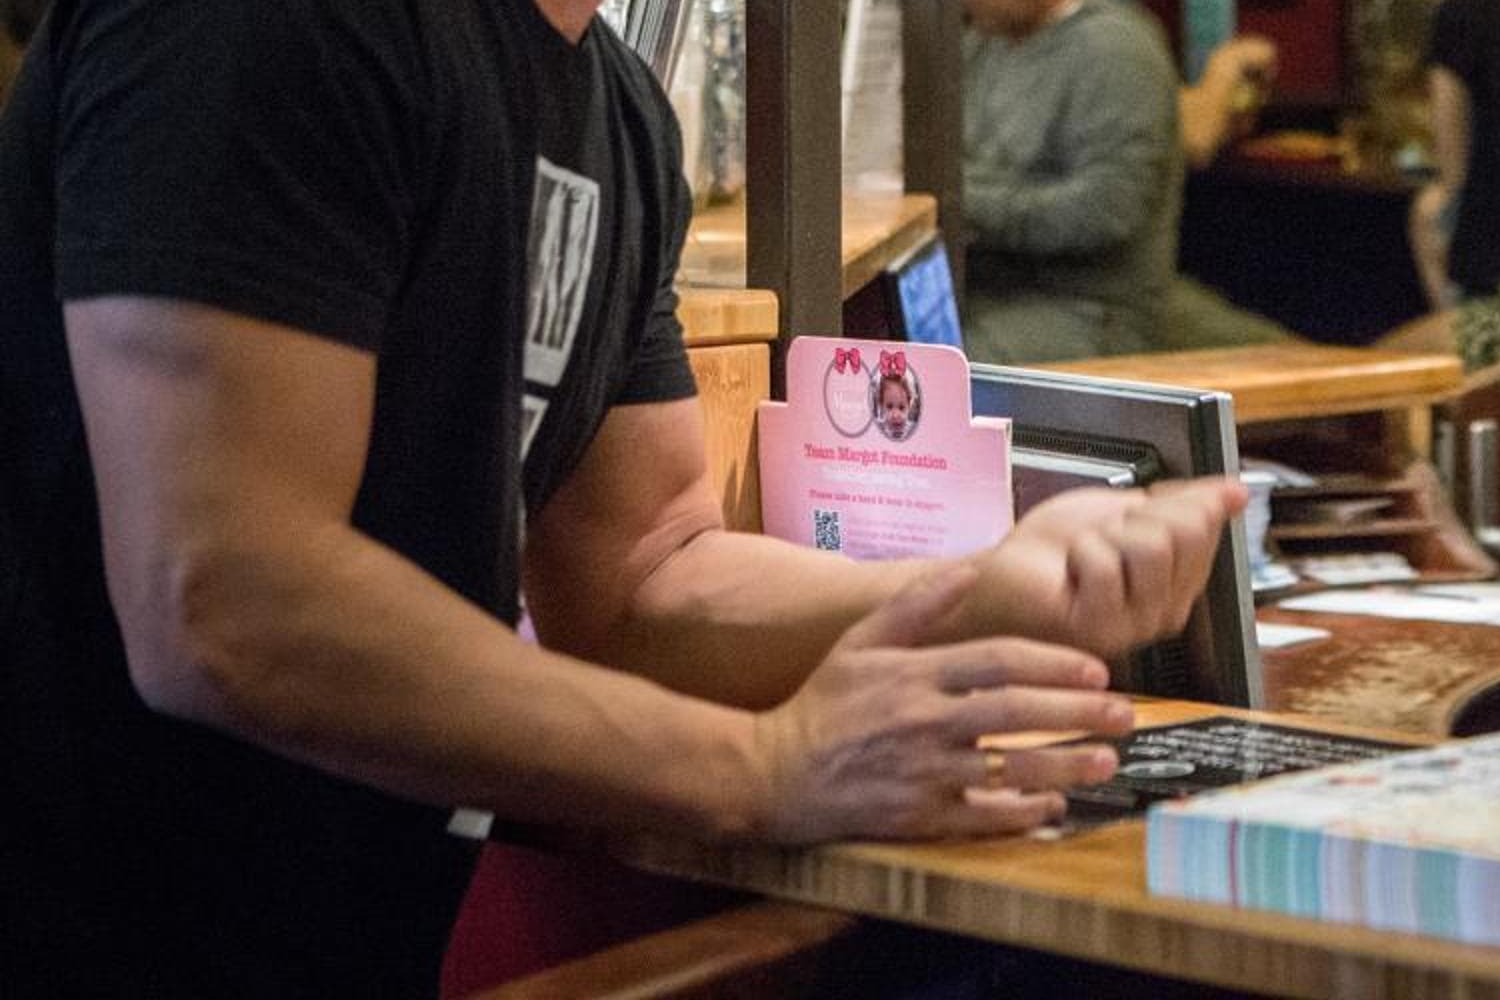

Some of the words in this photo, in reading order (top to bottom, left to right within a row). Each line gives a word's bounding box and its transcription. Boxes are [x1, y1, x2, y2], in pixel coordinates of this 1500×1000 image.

[804, 443, 835, 460] Team
[838, 446, 878, 466] Margot
[881, 450, 948, 470] Foundation
